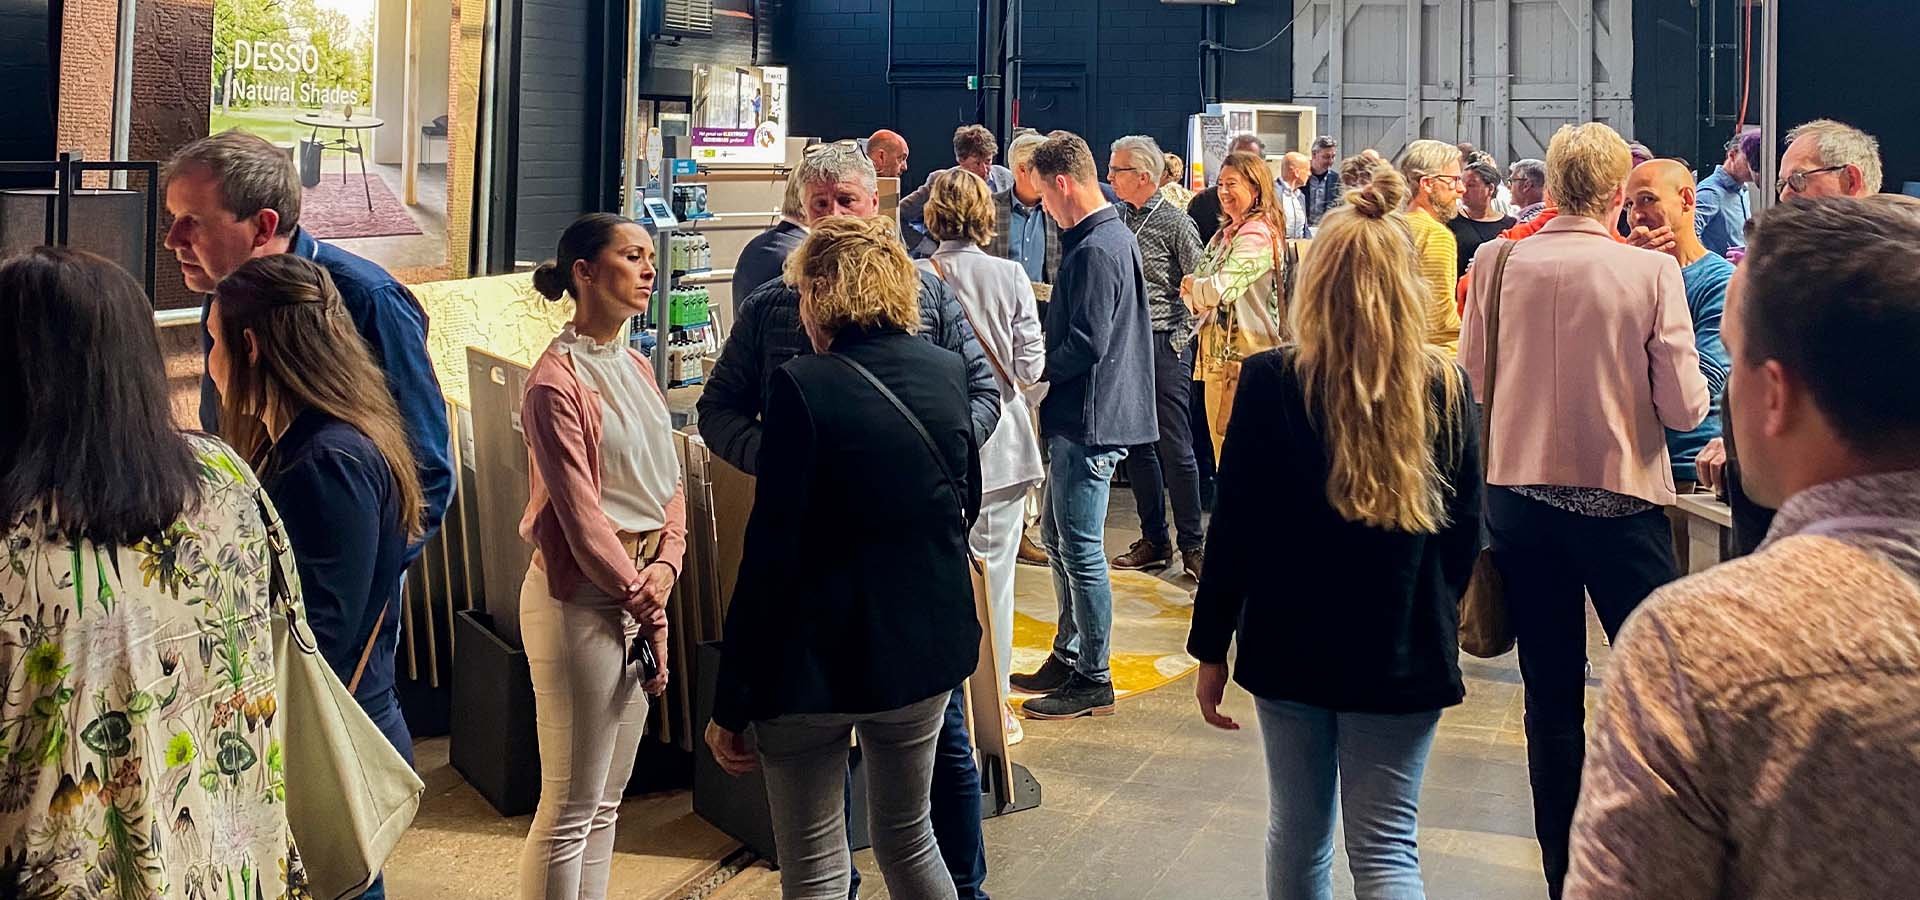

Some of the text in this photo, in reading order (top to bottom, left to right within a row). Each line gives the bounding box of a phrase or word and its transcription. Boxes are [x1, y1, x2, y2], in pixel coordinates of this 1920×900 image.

[234, 39, 319, 74] DESSO
[232, 78, 359, 105] Natural Shades
